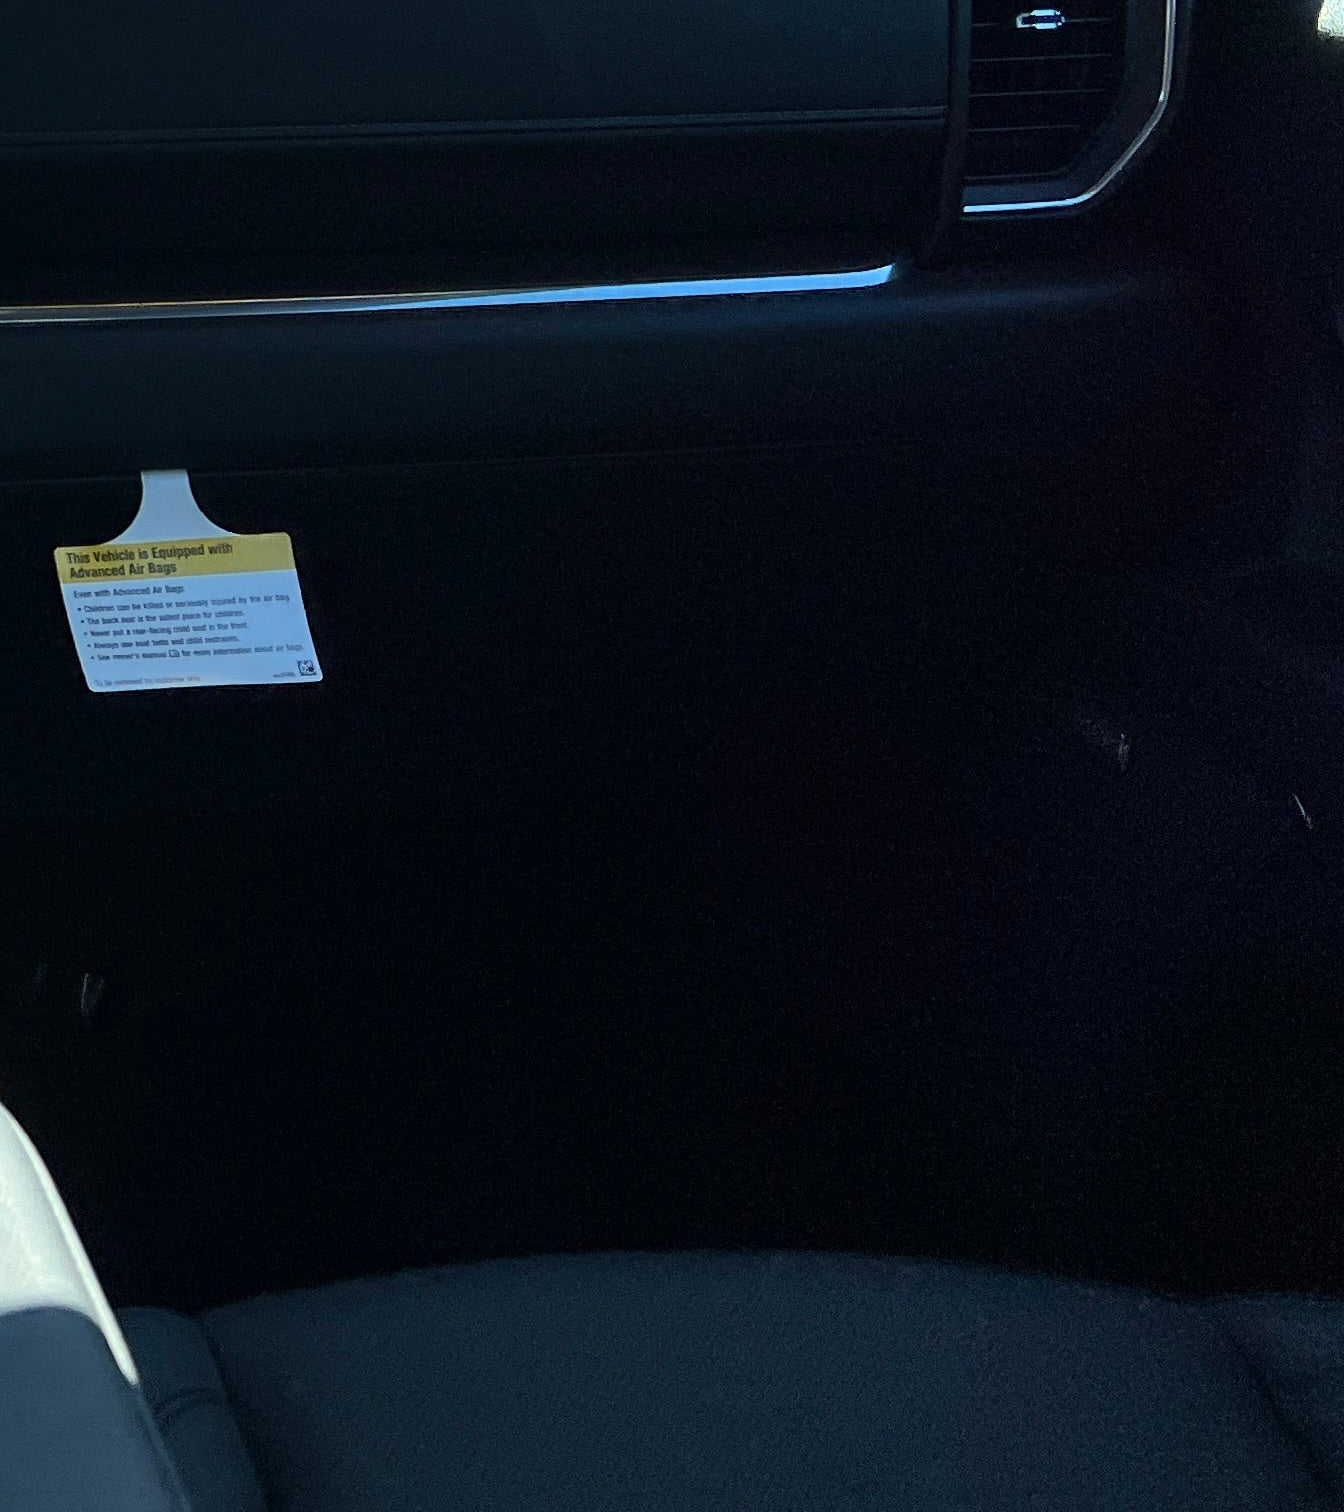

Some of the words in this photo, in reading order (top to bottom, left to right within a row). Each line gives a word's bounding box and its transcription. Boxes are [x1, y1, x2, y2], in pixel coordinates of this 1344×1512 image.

[67, 552, 90, 564] This
[93, 549, 135, 562] Vehicle
[139, 548, 148, 560] is
[151, 544, 204, 560] Equipped
[208, 543, 233, 555] with
[70, 565, 125, 579] Advanced
[129, 563, 144, 574] Air
[148, 562, 177, 575] Bags
